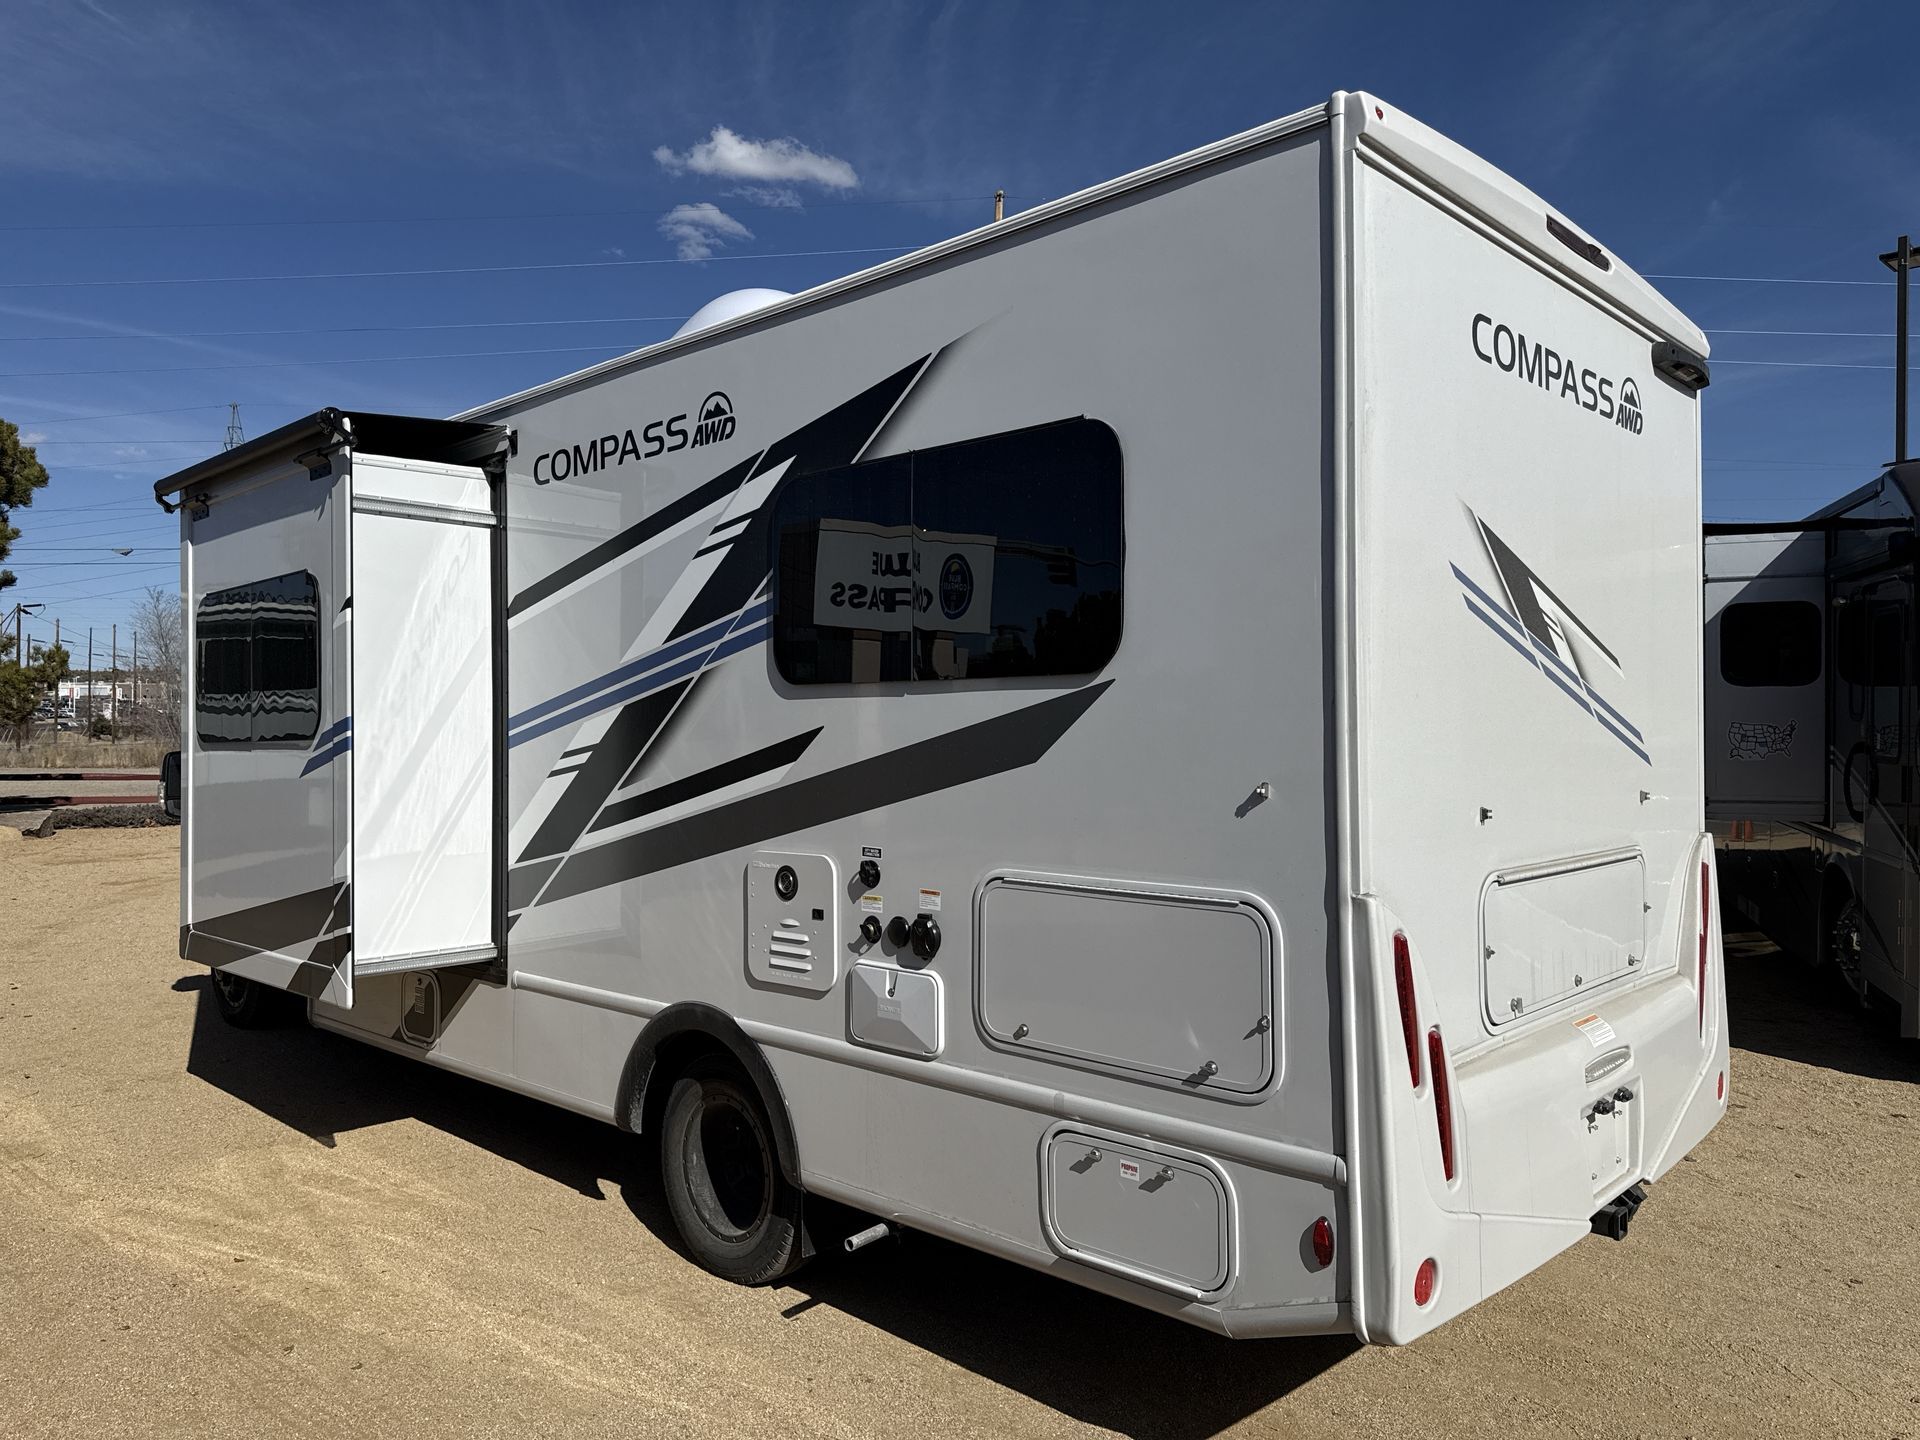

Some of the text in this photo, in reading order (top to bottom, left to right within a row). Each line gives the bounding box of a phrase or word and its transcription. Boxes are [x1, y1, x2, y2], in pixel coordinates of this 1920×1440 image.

[1472, 313, 1643, 435] COMPASS AWD
[533, 413, 736, 486] COMPASS AWD
